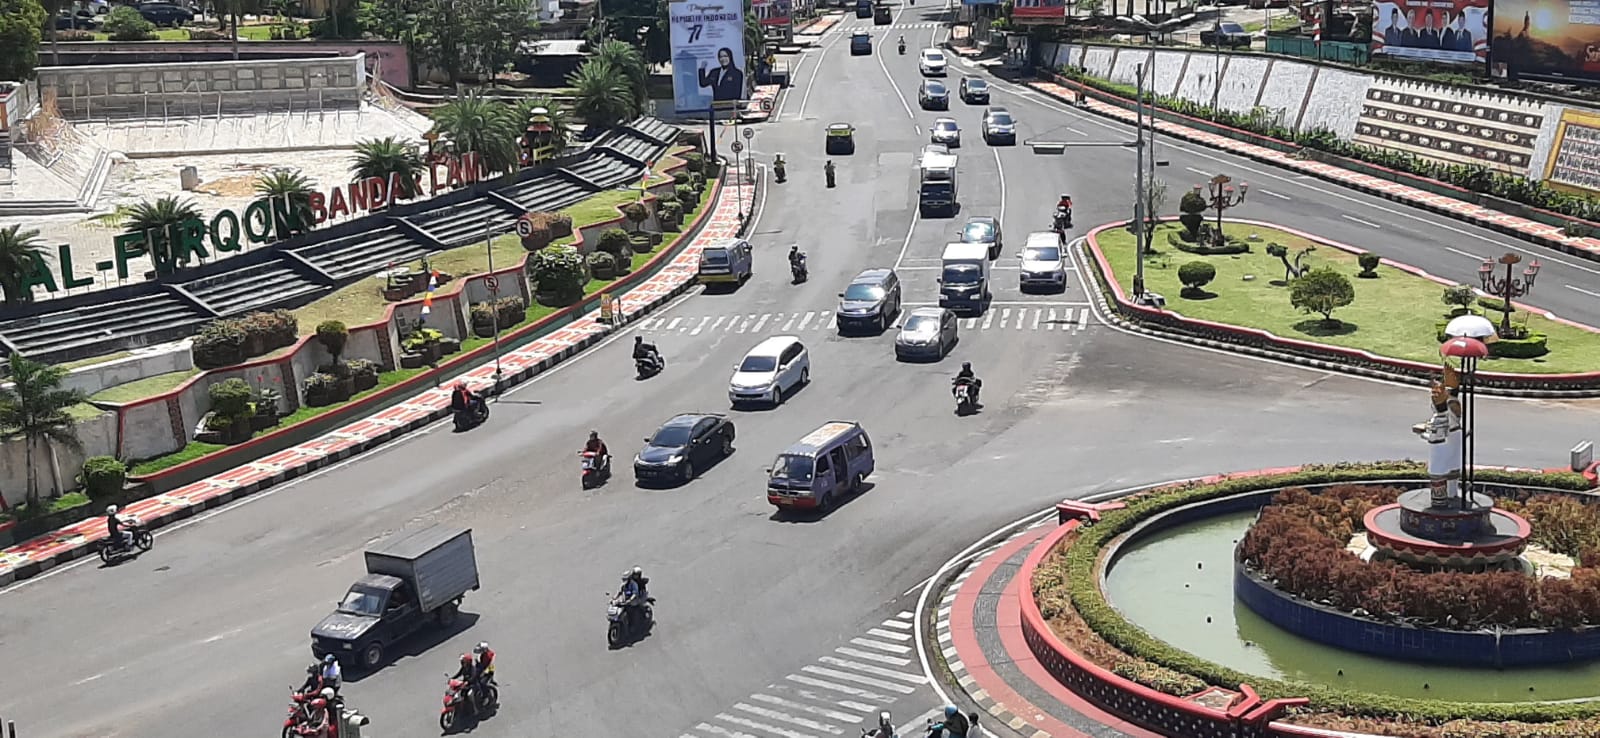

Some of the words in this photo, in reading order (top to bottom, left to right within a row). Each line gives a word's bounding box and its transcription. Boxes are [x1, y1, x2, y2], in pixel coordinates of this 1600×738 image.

[687, 24, 703, 43] 77
[763, 100, 770, 108] S
[309, 171, 425, 224] BANDAR
[520, 222, 529, 235] S
[487, 277, 495, 288] S
